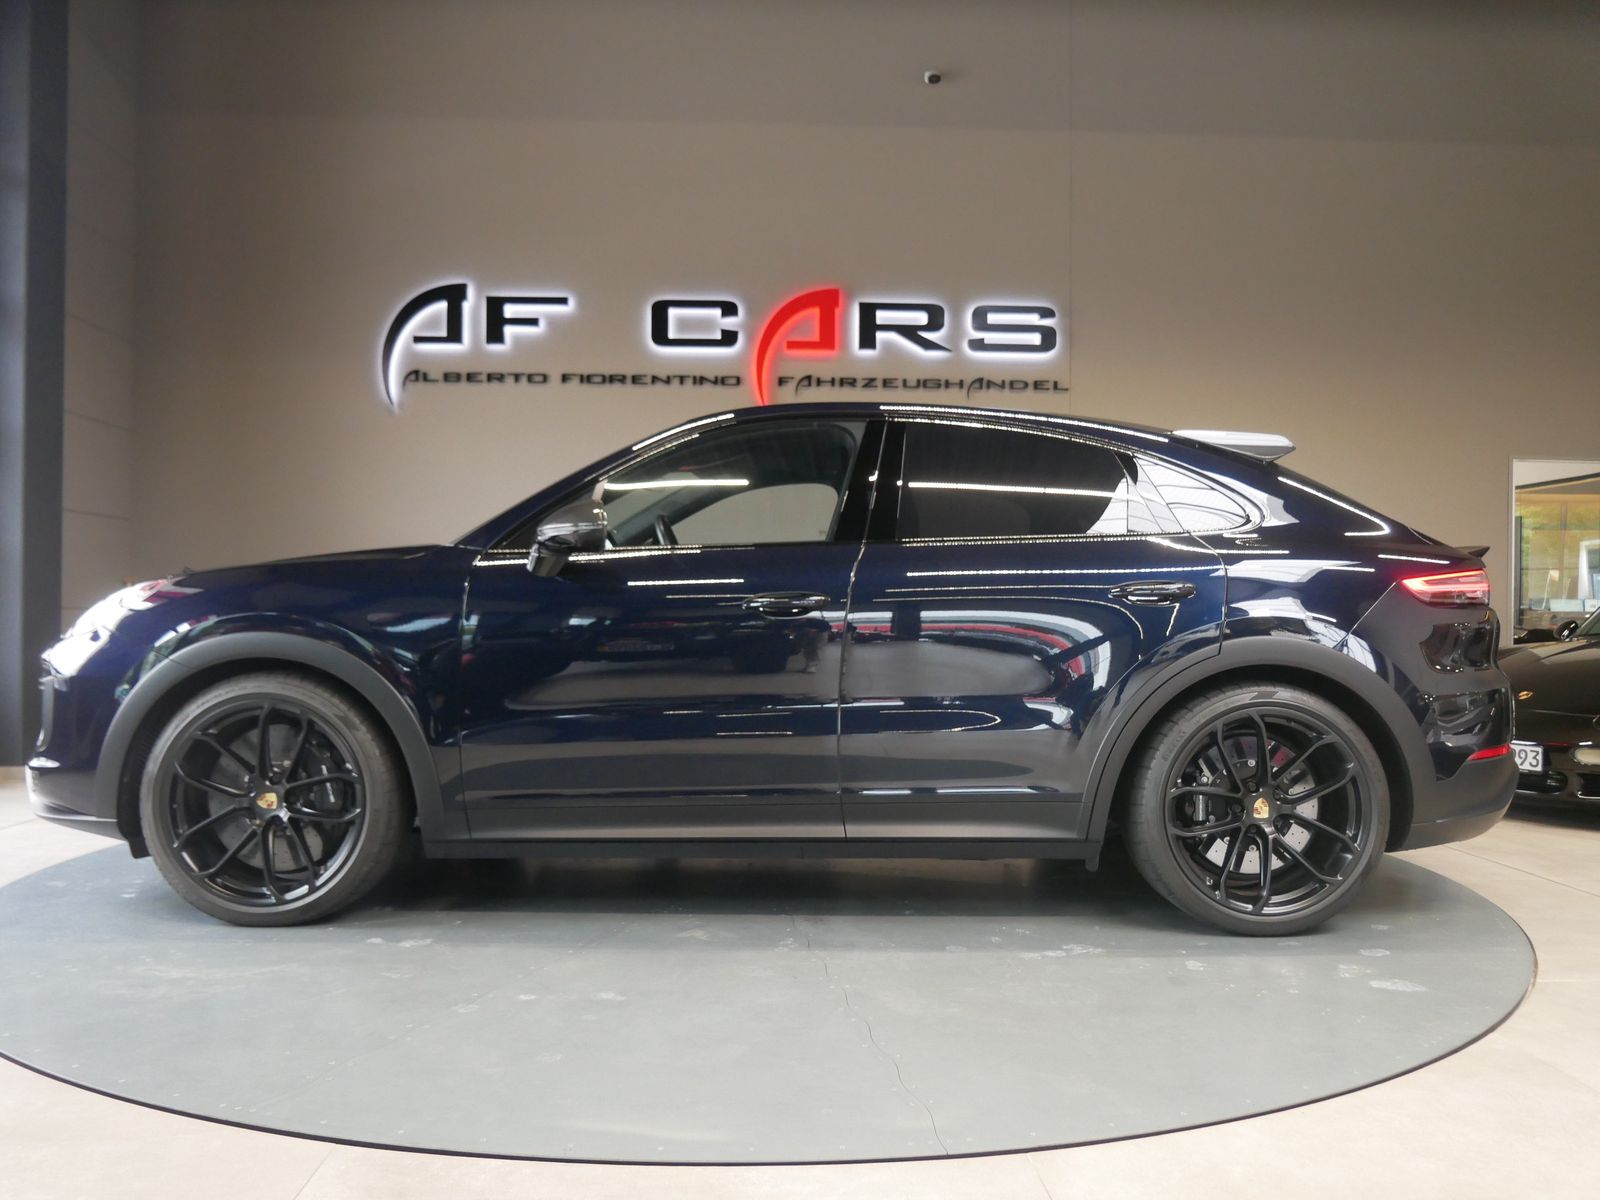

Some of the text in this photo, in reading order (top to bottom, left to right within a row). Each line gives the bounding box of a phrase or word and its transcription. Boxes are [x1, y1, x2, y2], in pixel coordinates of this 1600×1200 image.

[382, 283, 1057, 406] AF CARS
[403, 369, 1070, 400] ALBERTO FIORENTINO FAHRZEUGHANDEL
